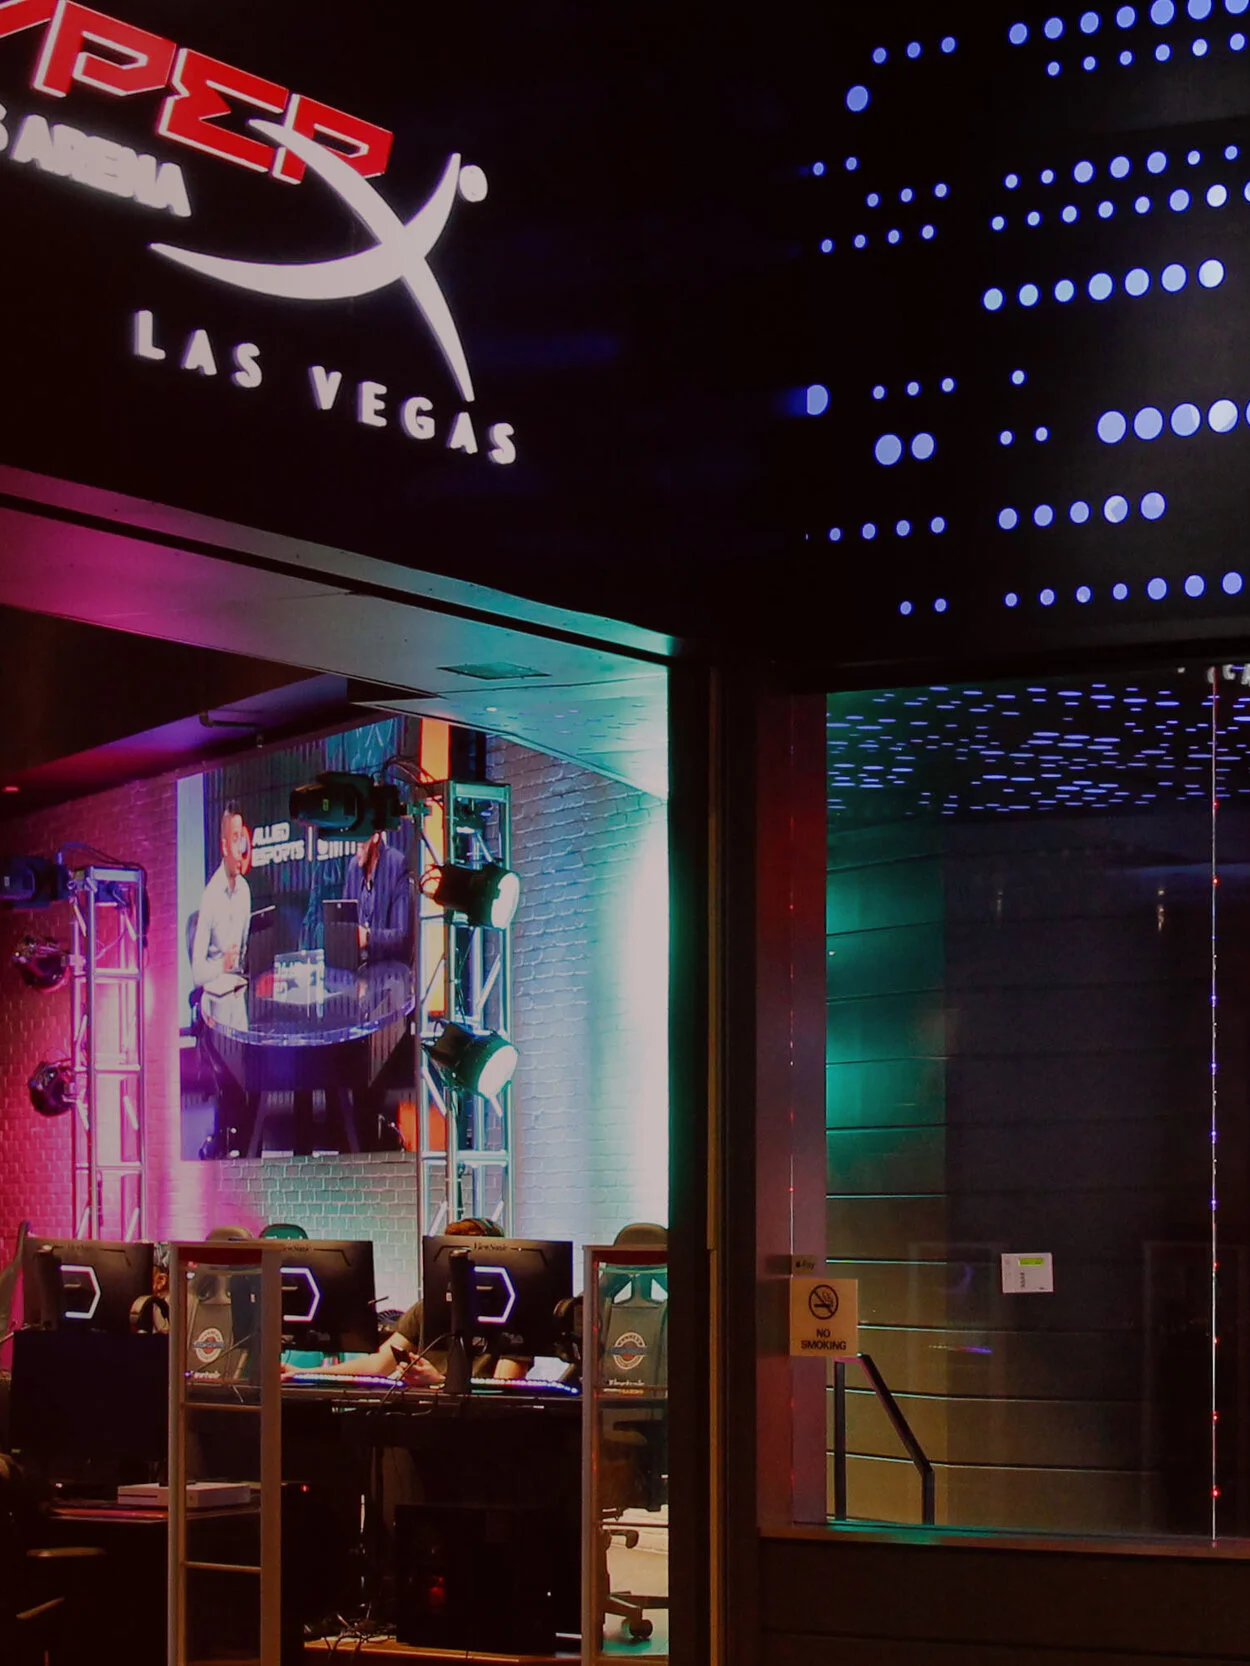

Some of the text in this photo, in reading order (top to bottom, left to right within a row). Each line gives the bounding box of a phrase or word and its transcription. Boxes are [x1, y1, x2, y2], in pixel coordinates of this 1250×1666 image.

[11, 113, 192, 218] ARENA
[133, 309, 517, 465] LAS VEGAS
[251, 840, 305, 867] ESPORTS
[801, 1341, 847, 1351] SMOKING
[816, 1328, 831, 1338] NO
